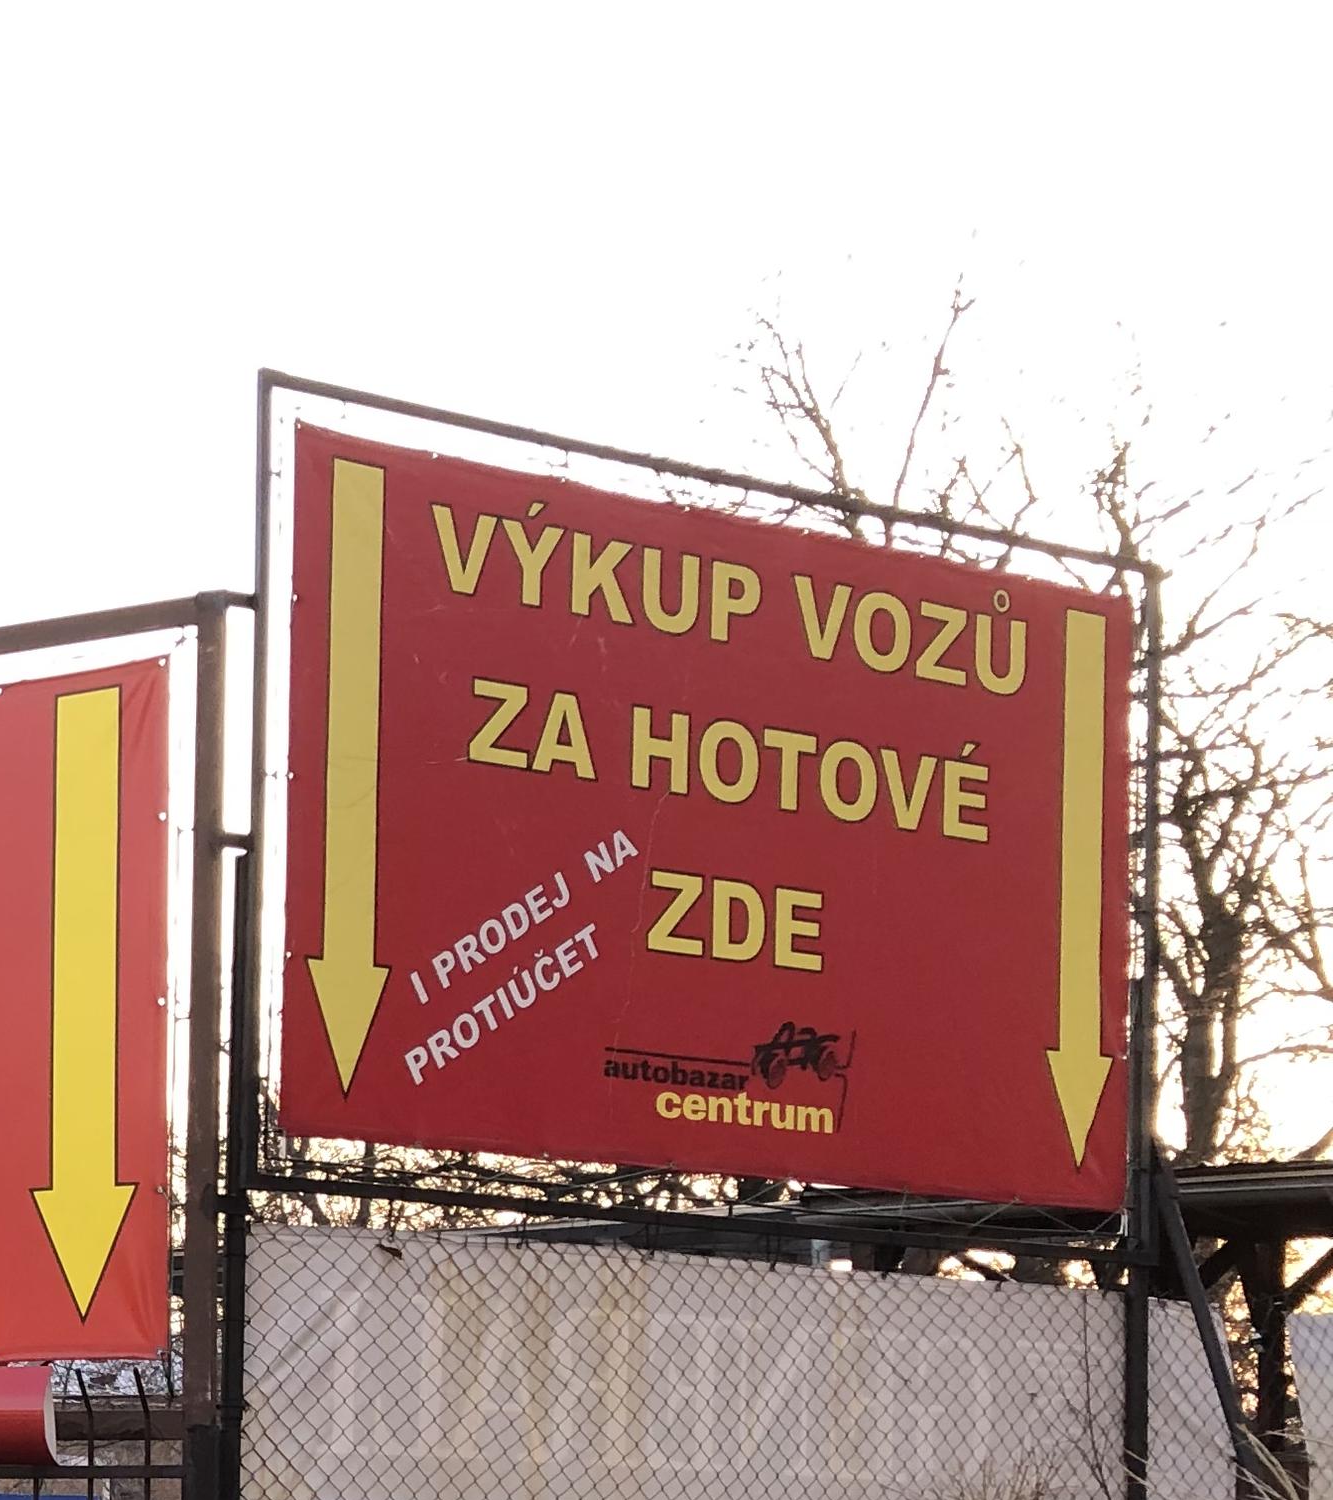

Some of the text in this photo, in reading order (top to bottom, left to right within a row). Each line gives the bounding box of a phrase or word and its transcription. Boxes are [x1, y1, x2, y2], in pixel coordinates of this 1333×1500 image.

[433, 506, 1026, 694] VÝKUP VOZŮ
[470, 680, 988, 841] ZA HOTOVÉ
[411, 831, 638, 1004] I PRODEJ NA
[648, 871, 821, 970] ZDE
[405, 926, 598, 1084] PROTIÚČET
[604, 1060, 748, 1090] autobazar
[656, 1092, 833, 1133] centrum
